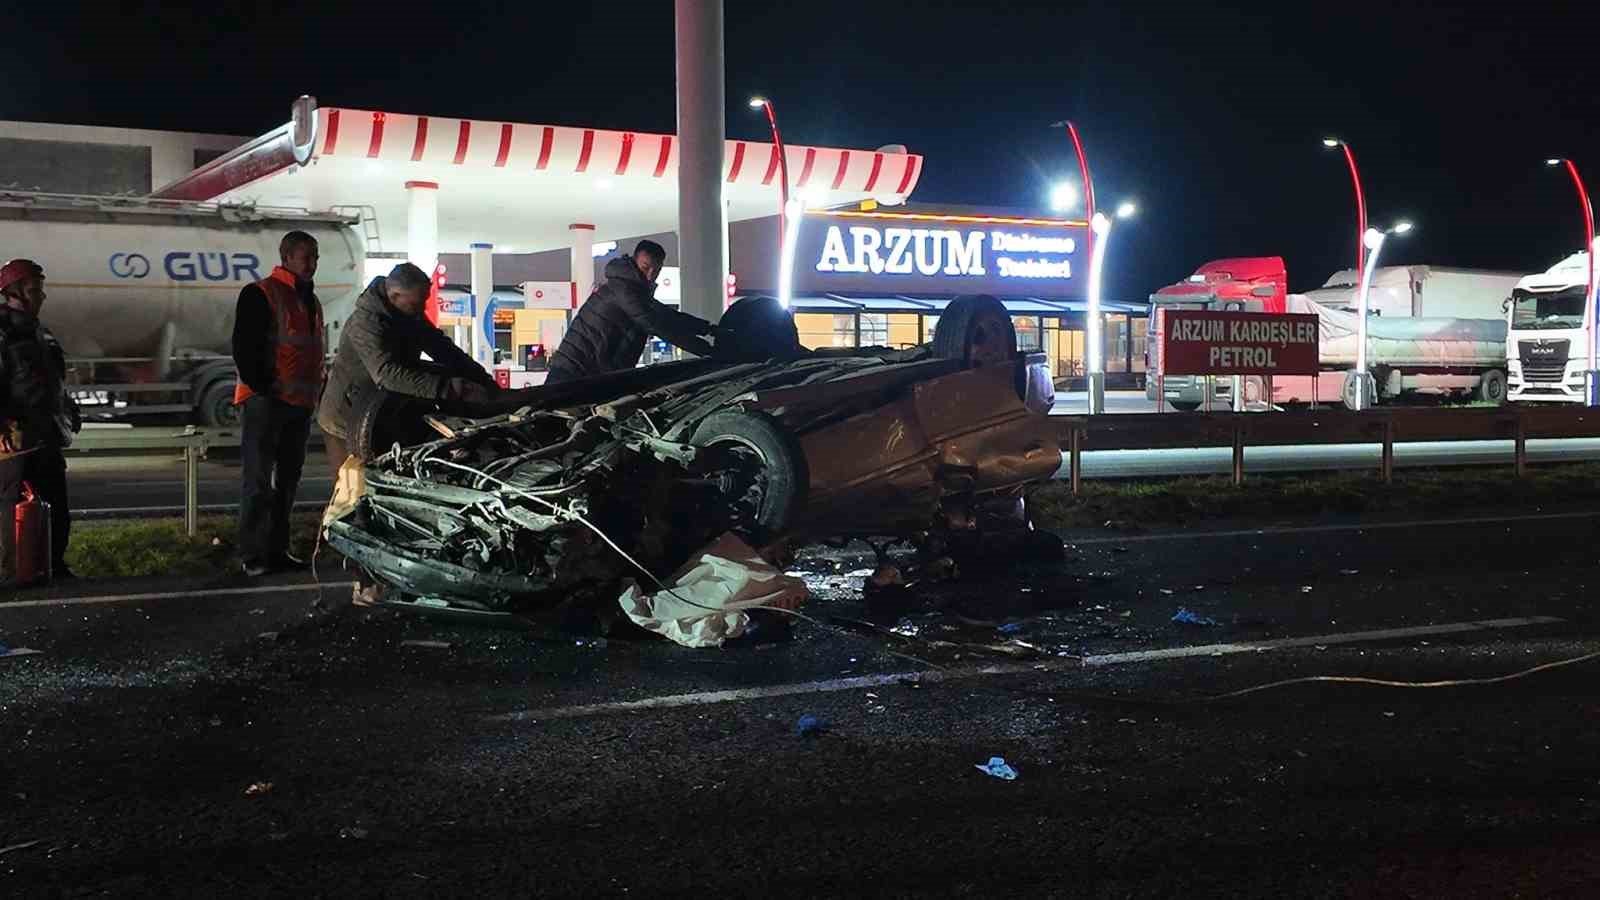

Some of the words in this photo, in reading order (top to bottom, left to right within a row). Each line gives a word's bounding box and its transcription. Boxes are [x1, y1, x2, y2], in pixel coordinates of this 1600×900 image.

[816, 225, 986, 276] ARZUM
[164, 252, 263, 281] GÜR
[1171, 319, 1225, 342] ARZUM
[1230, 320, 1316, 349] KARDEŞLER
[1209, 346, 1277, 368] PETROL
